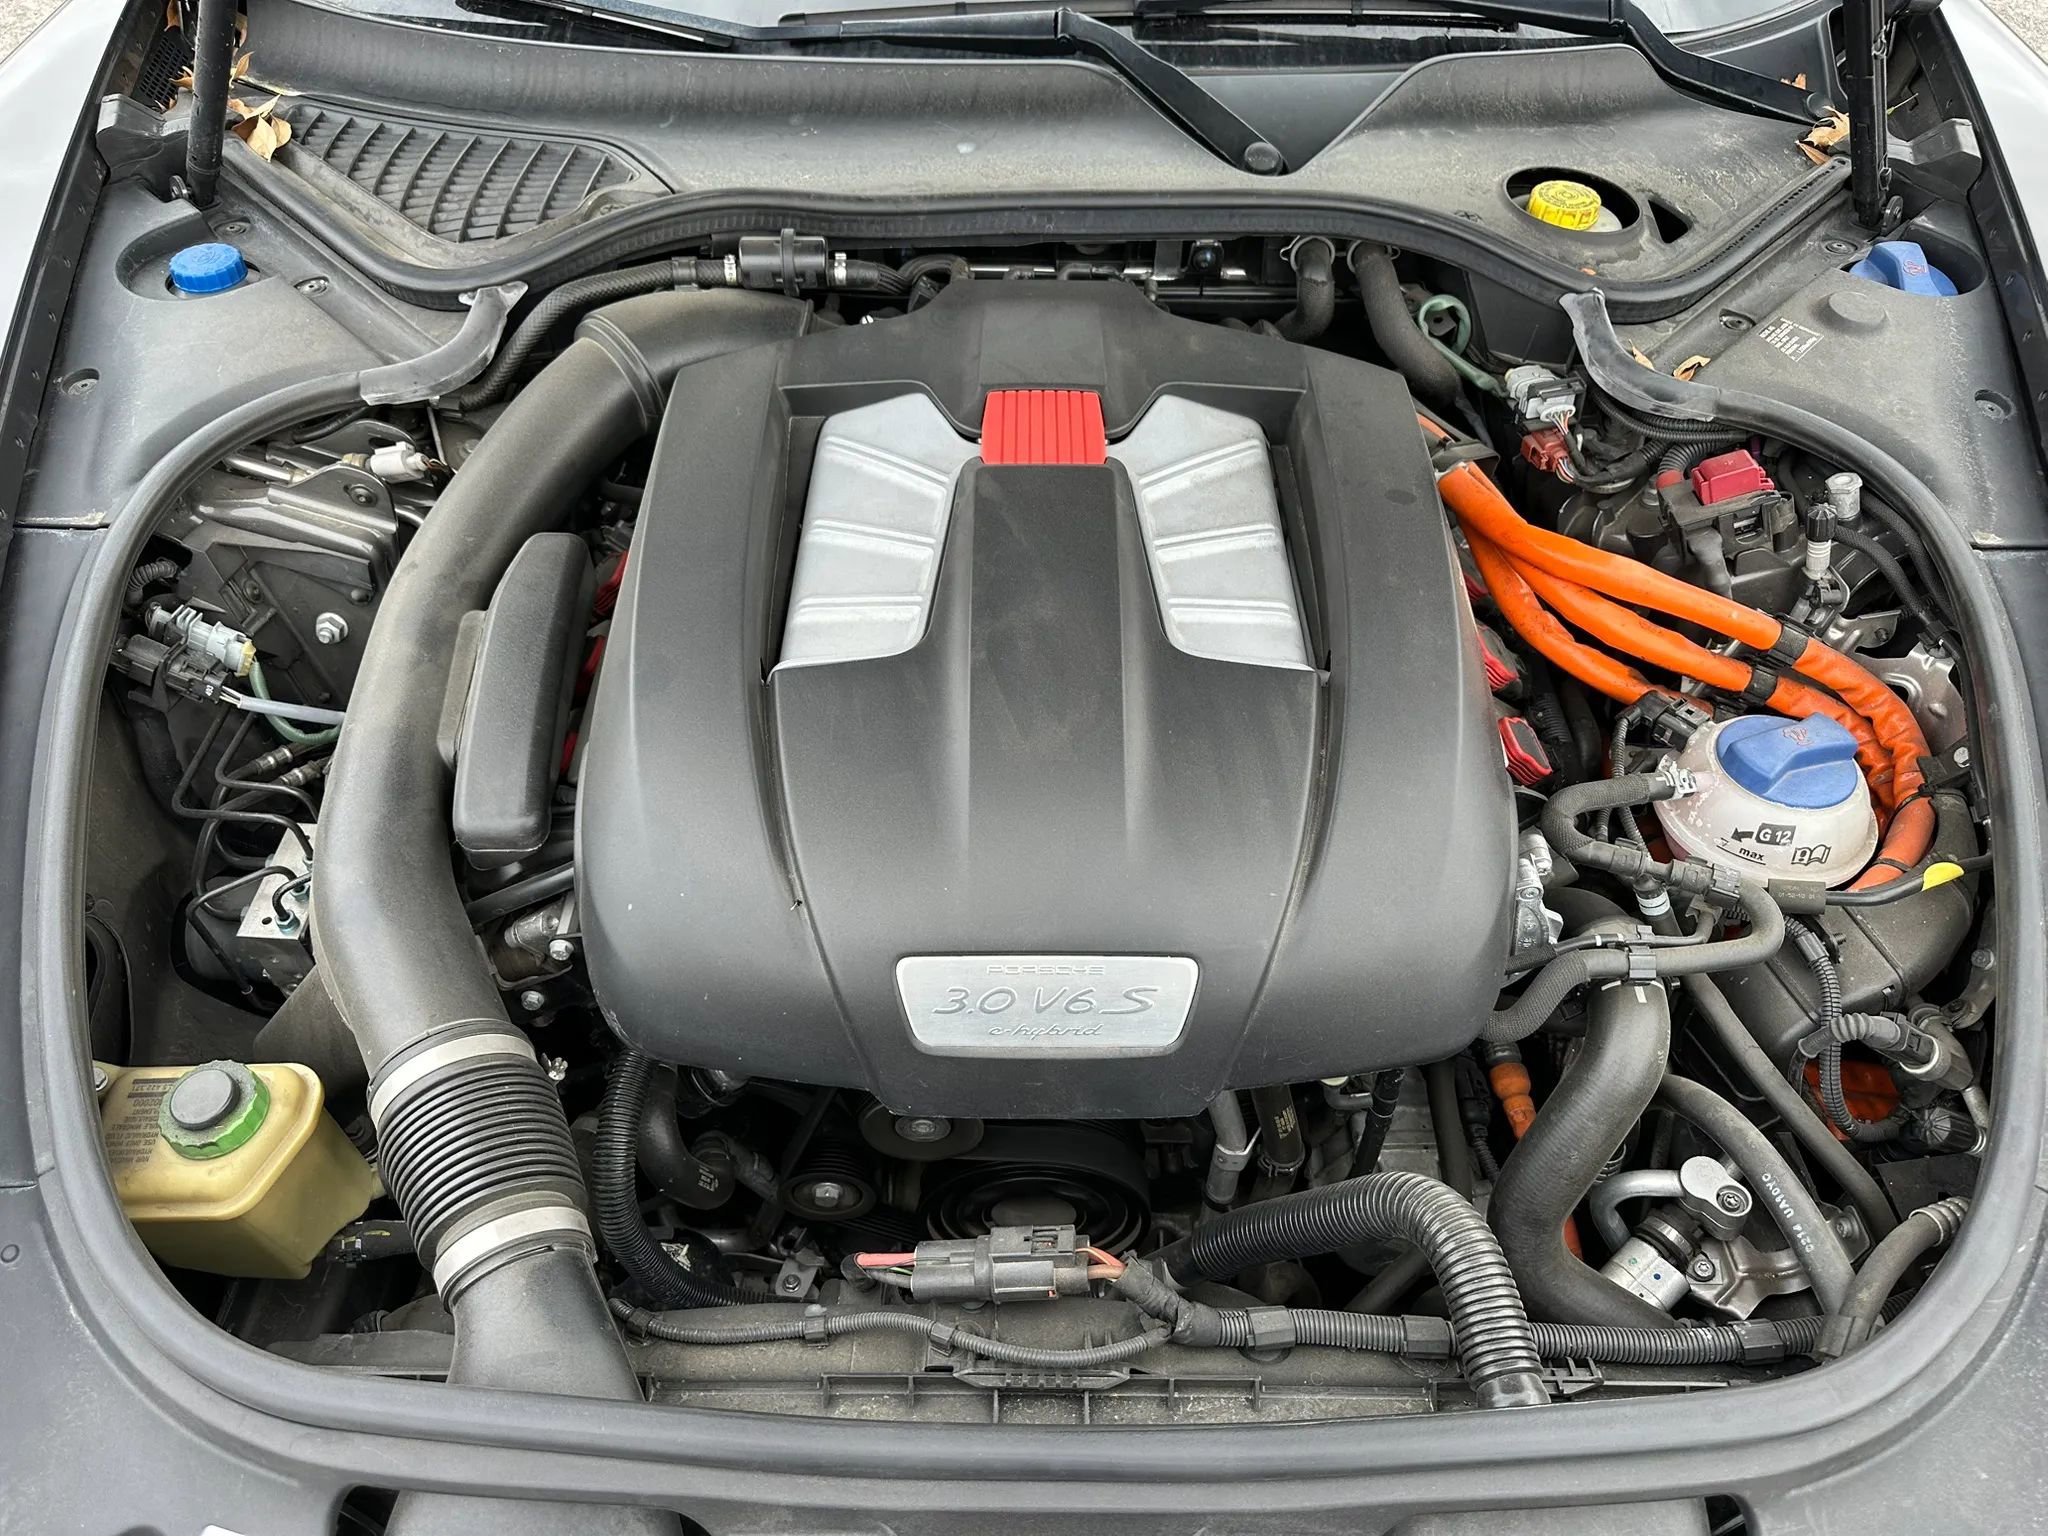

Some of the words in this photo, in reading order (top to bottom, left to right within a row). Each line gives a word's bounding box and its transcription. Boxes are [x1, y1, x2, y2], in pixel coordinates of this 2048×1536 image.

[1739, 847, 1765, 861] max
[986, 964, 1106, 976] PORSCHE
[932, 986, 1019, 1015] 3.0
[988, 1023, 1104, 1041] e-hybrid
